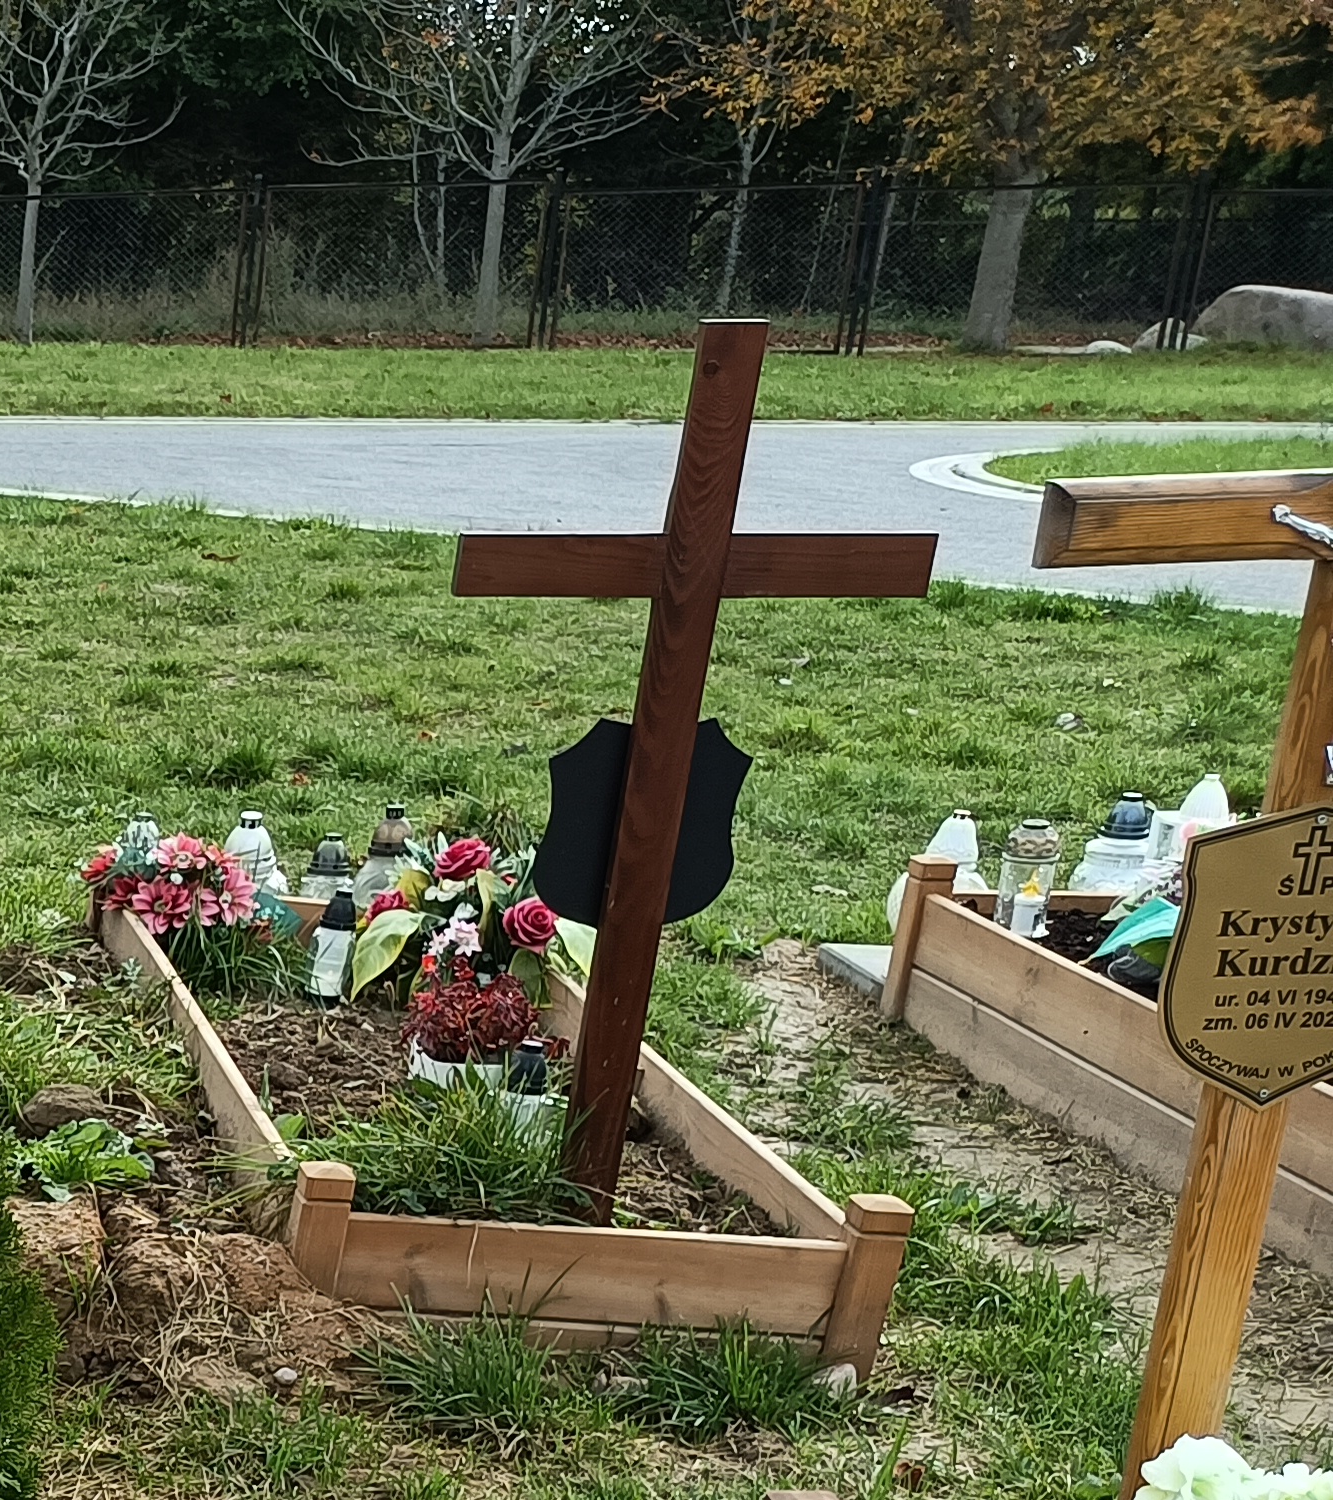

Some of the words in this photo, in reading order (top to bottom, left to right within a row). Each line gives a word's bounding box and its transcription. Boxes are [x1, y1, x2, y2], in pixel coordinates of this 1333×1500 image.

[1278, 873, 1295, 896] Ś
[1213, 947, 1333, 978] Kurdz
[1214, 994, 1240, 1007] ur.
[1246, 989, 1271, 1006] 04
[1277, 989, 1298, 1006] VI
[1202, 1017, 1238, 1031] zm.
[1244, 1012, 1270, 1030] 06
[1274, 1012, 1297, 1029] IV
[1185, 1038, 1270, 1079] SPOCZYWAJ
[1277, 1065, 1295, 1077] W
